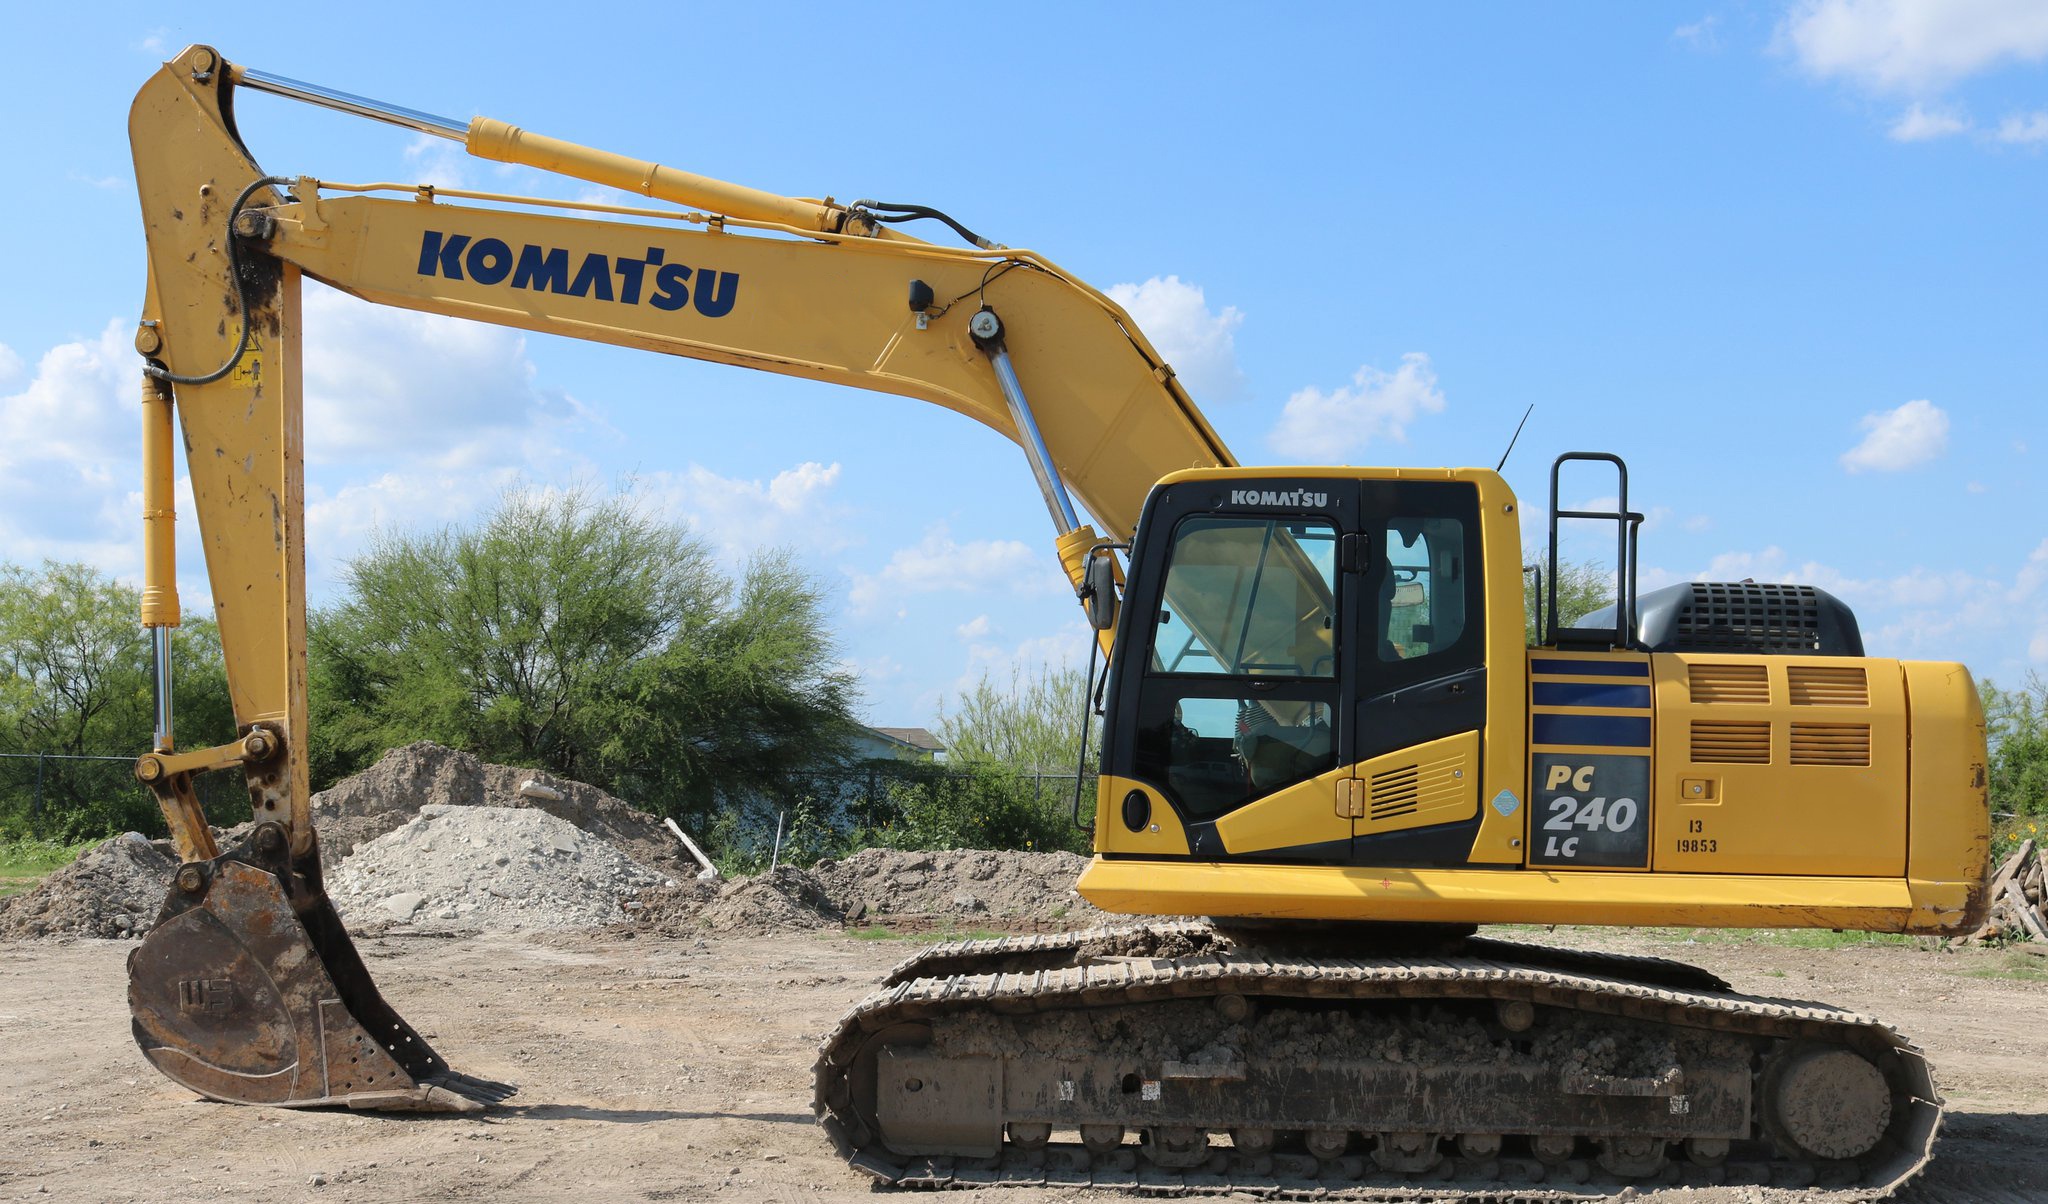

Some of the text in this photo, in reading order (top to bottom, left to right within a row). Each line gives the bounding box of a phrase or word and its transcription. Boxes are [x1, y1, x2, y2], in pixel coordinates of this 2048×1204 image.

[417, 230, 739, 318] KOMATSU
[1231, 488, 1328, 508] KOMATSU
[1546, 765, 1595, 792] PC
[1543, 796, 1638, 833] 240
[1689, 819, 1703, 833] 13
[1544, 837, 1579, 858] LC
[1677, 839, 1717, 853] 19853
